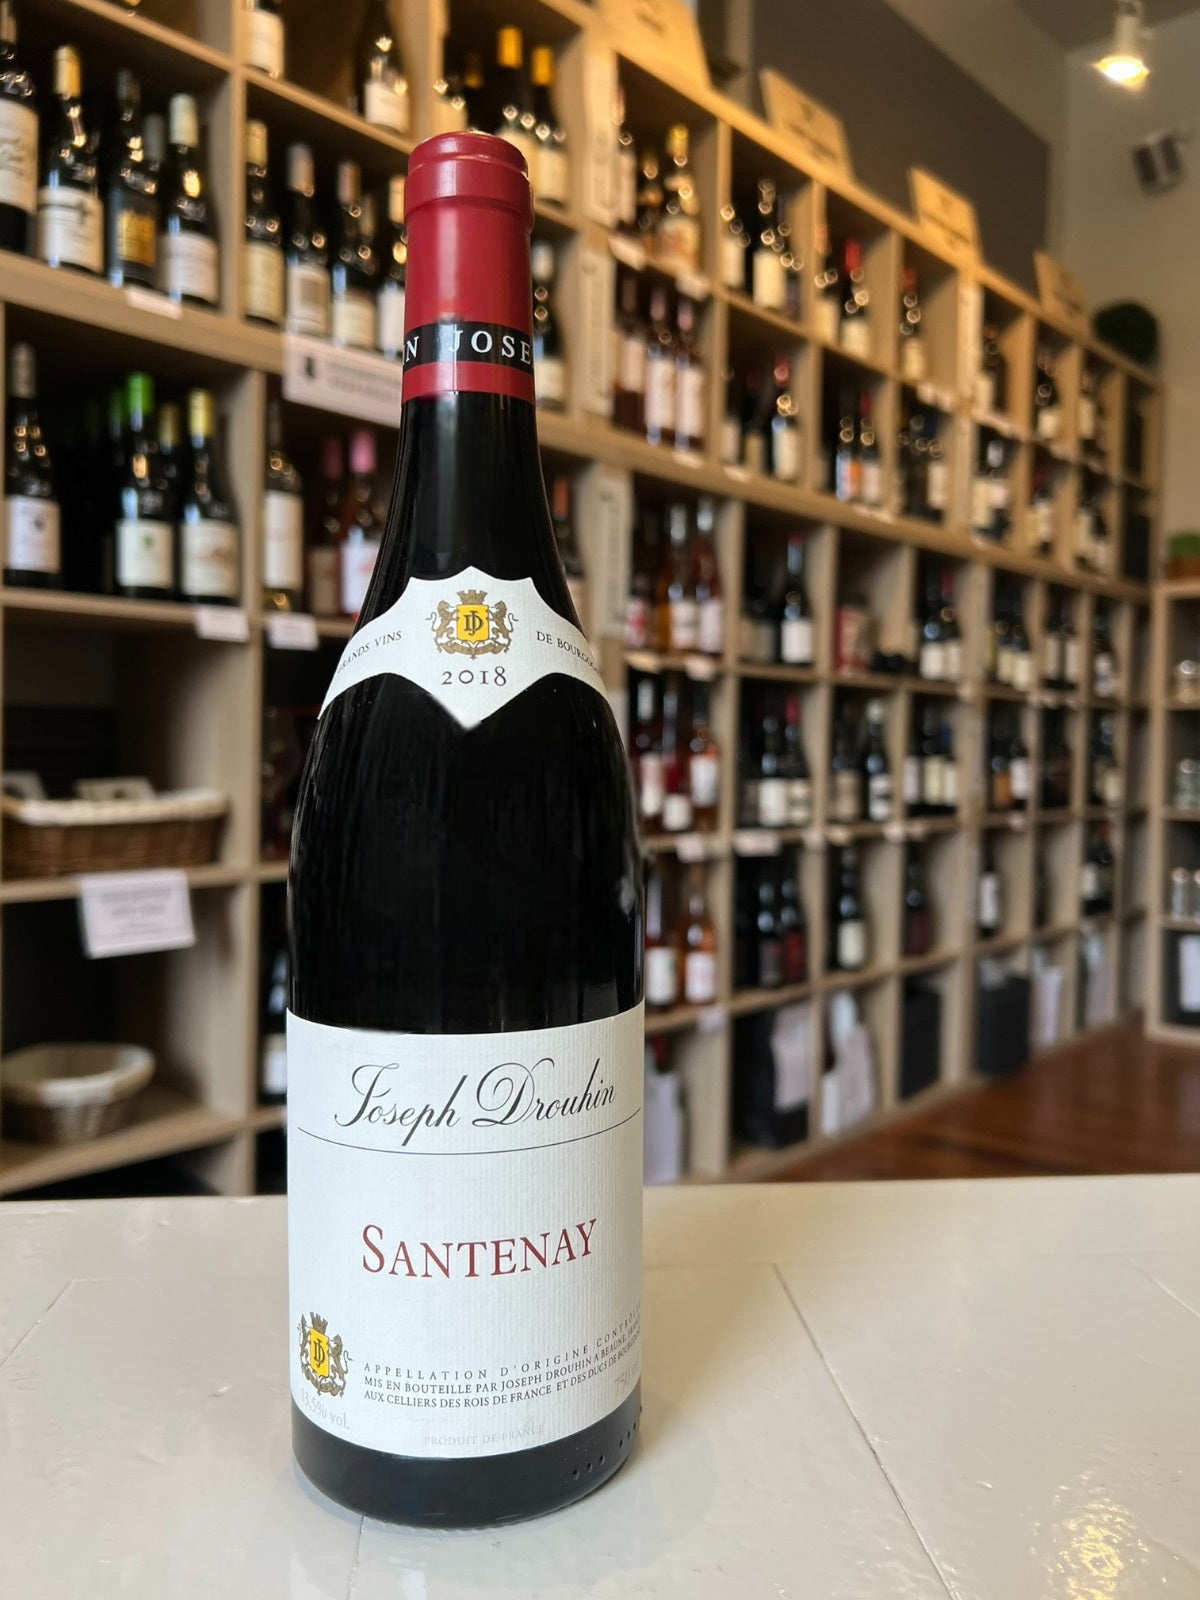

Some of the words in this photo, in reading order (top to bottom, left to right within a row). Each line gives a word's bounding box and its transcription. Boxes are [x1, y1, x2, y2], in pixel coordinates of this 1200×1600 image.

[448, 329, 531, 365] JOSE
[374, 630, 402, 647] VINS
[536, 630, 553, 645] DE
[442, 666, 506, 687] 2018
[334, 1062, 468, 1146] Joseph
[472, 1057, 616, 1128] Drouhin
[362, 1218, 597, 1279] SANTENAY
[364, 1362, 487, 1380] APPELLATION
[364, 1376, 383, 1389] MIS
[386, 1380, 401, 1391] EN
[404, 1383, 472, 1395] BOUTEILLE
[476, 1382, 498, 1394] PAR
[500, 1373, 541, 1393] JOSEPH
[546, 1356, 592, 1381] DROUHIN
[364, 1390, 384, 1403] AUX
[386, 1394, 437, 1408] CELLIERS
[440, 1398, 461, 1409] DES
[464, 1396, 490, 1408] ROIS
[493, 1395, 507, 1406] DE
[510, 1385, 552, 1403] FRANCE
[556, 1378, 569, 1392] ET
[570, 1373, 587, 1387] DES
[588, 1361, 608, 1380] DUCS
[609, 1355, 617, 1368] DE
[329, 1412, 350, 1430] vol.
[424, 1435, 478, 1446] PRODUIT
[482, 1433, 498, 1444] DE
[501, 1424, 545, 1442] FRANCE
